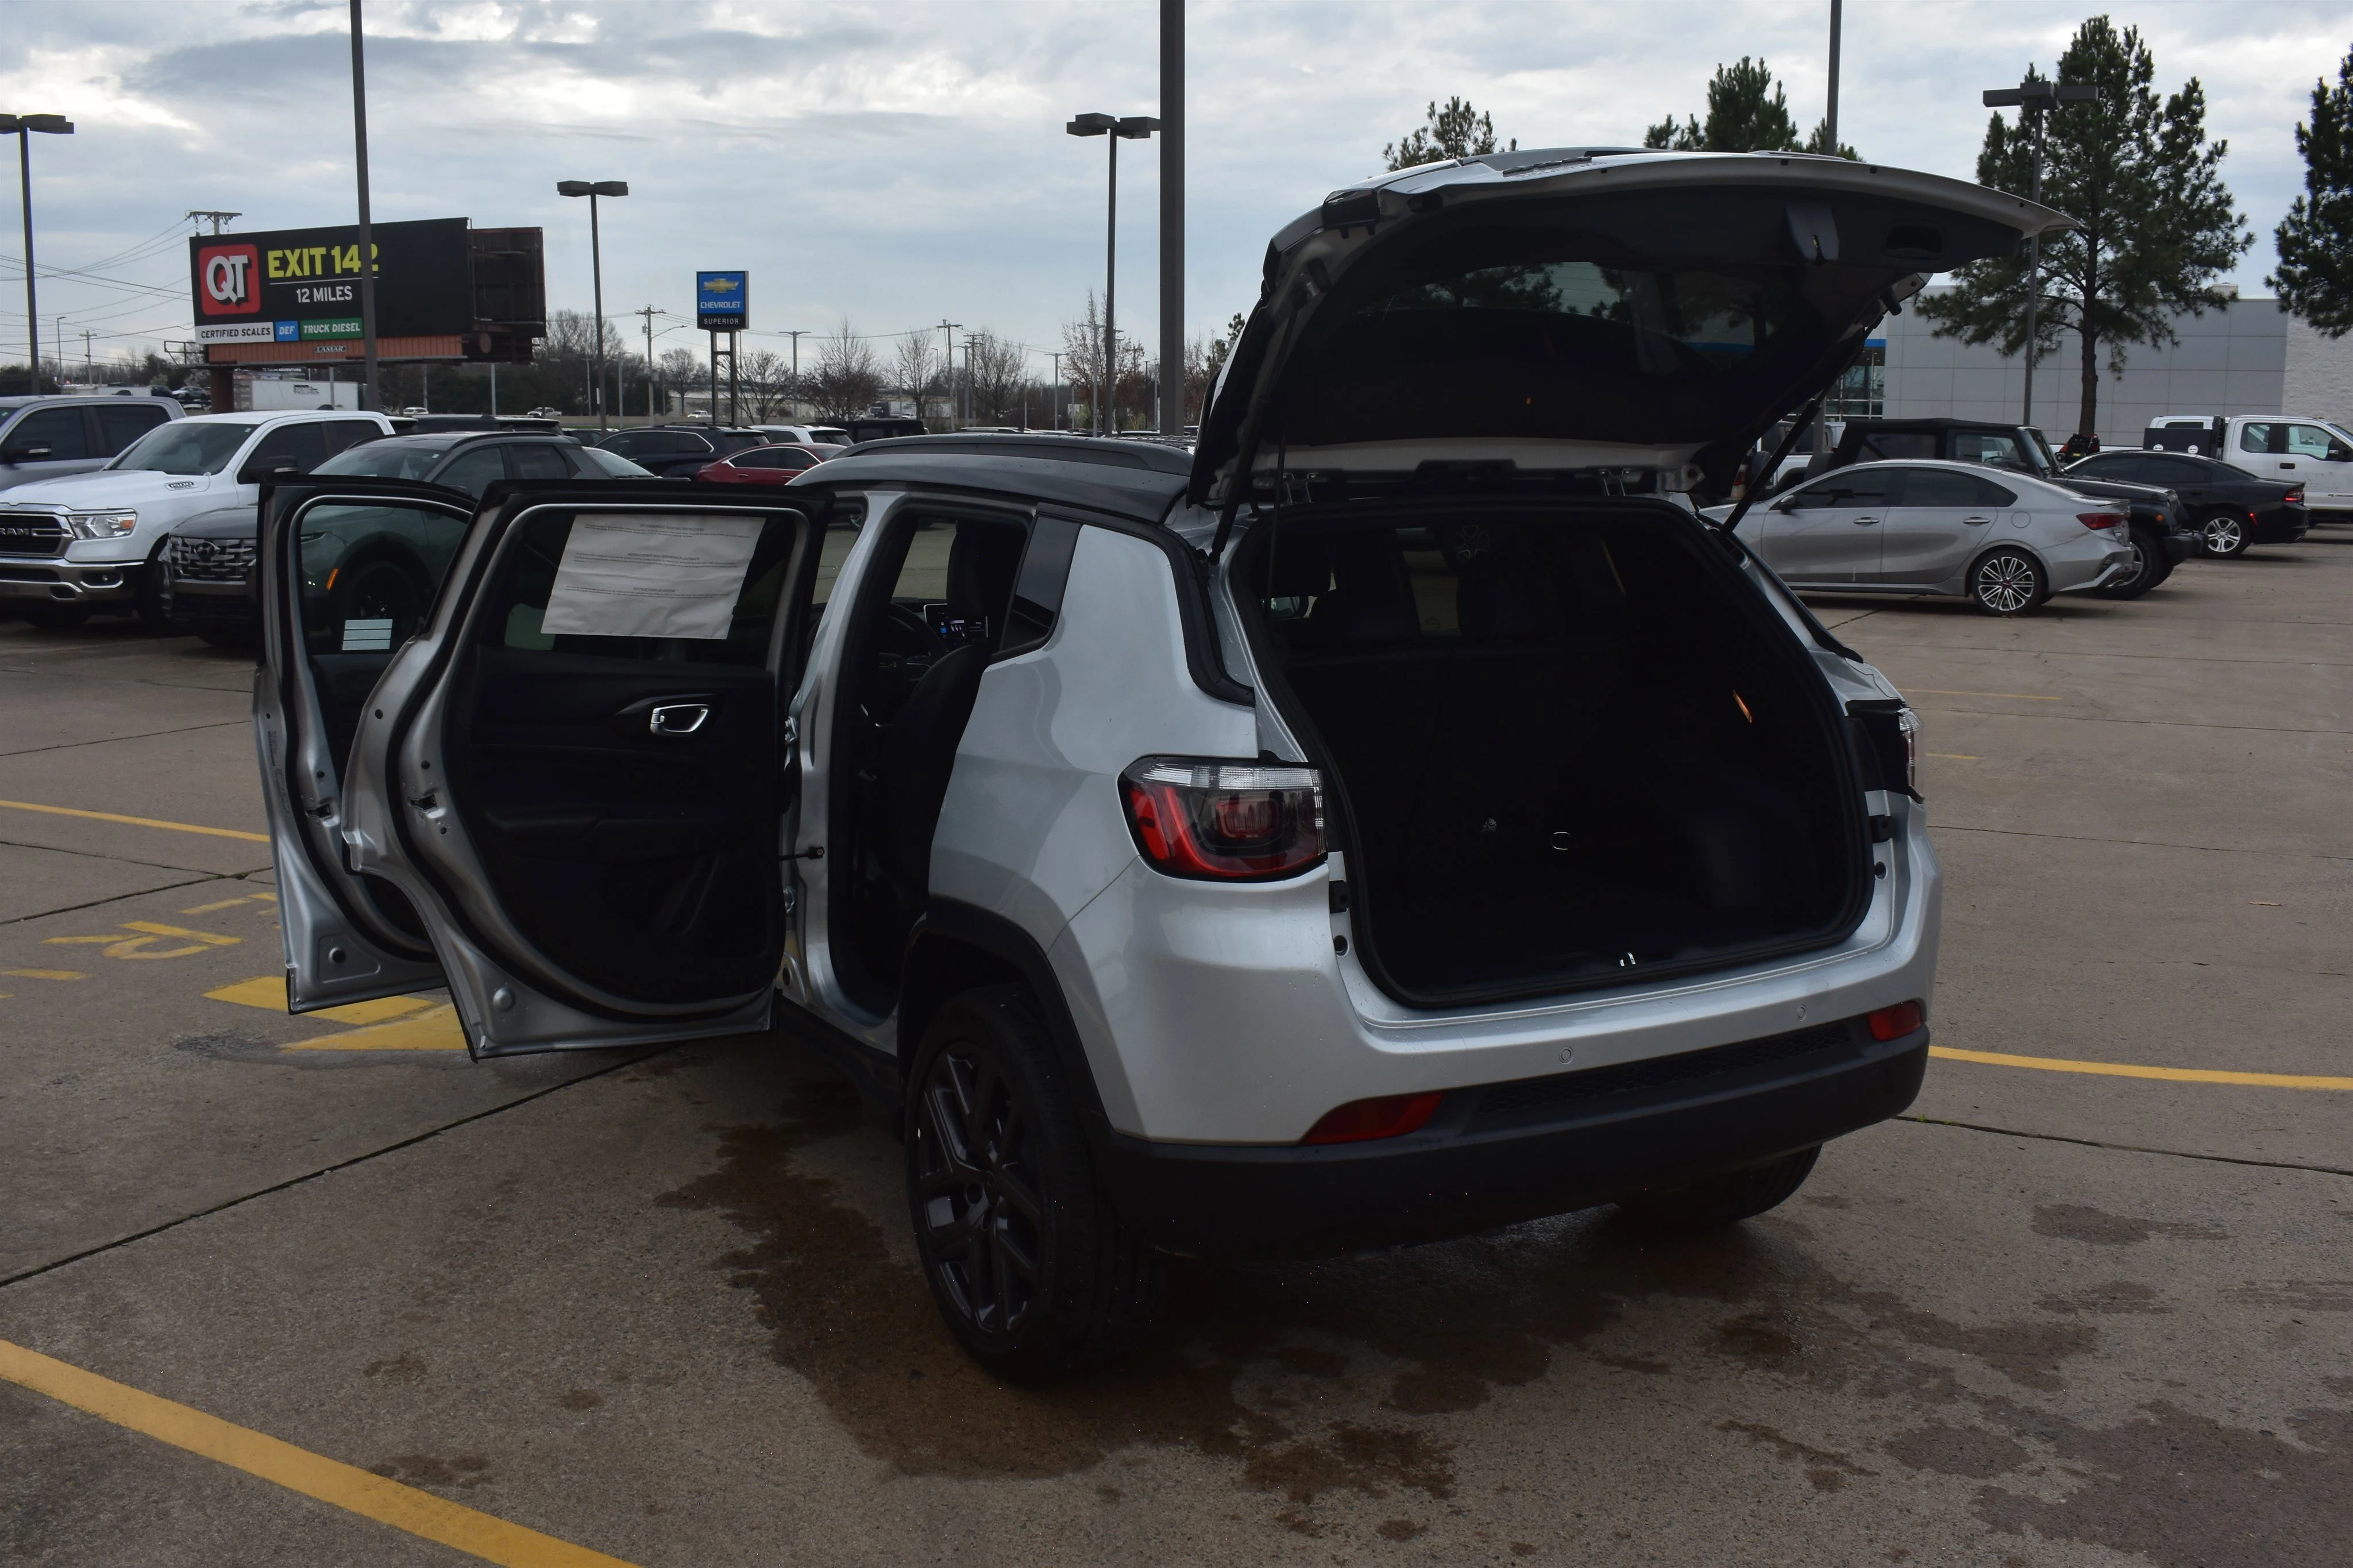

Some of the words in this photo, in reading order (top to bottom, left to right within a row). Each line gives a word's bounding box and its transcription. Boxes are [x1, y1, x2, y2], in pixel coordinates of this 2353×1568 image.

[268, 247, 326, 278] EXIT
[206, 255, 248, 303] QT
[296, 288, 310, 303] 12
[313, 285, 353, 302] MILES
[201, 329, 239, 338] CERTIFIED
[241, 327, 271, 337] SCALES
[279, 326, 295, 335] DEF
[303, 324, 330, 334] TRUCK
[332, 322, 361, 333] DIESEL
